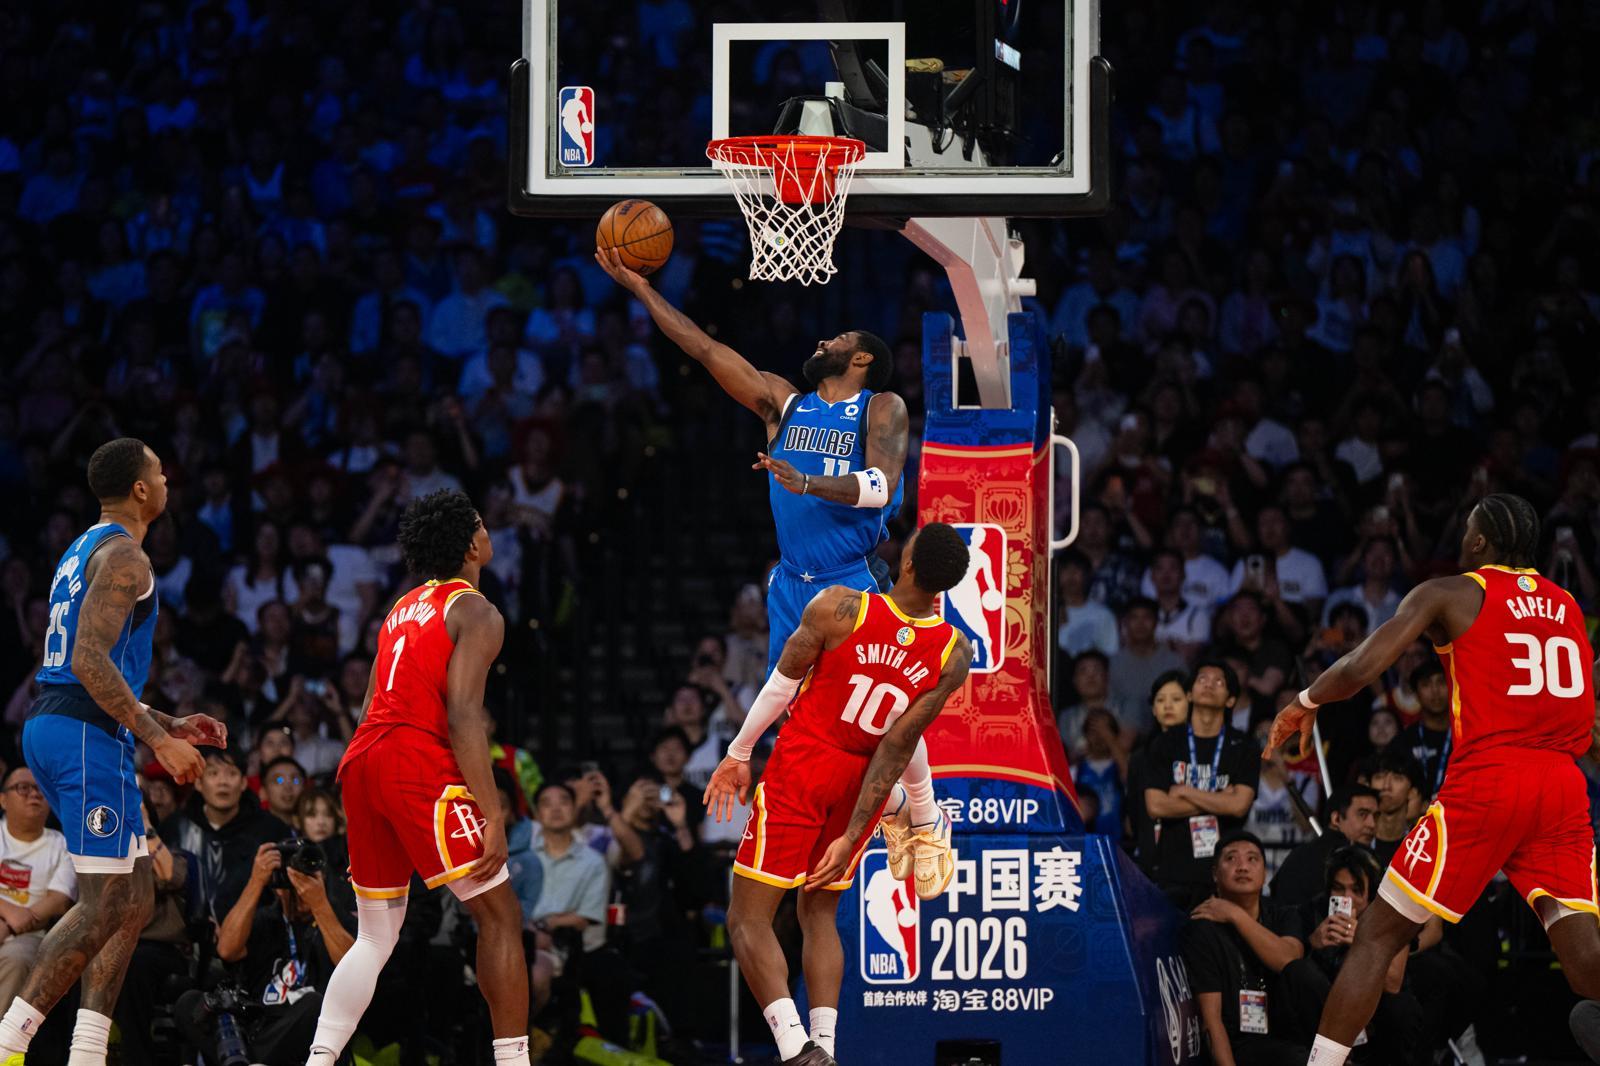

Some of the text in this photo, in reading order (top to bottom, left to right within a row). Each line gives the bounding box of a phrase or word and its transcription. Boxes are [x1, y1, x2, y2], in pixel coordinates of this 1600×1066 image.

[564, 148, 581, 161] NBA
[784, 425, 856, 458] DALLAS
[386, 601, 437, 635] THOMPSON
[1506, 595, 1566, 625] CAPELA
[43, 601, 71, 667] 25
[385, 634, 406, 692] 1
[855, 643, 930, 689] SMITH JR.
[1503, 632, 1585, 699] 30
[840, 673, 910, 736] 10
[943, 846, 1082, 913] 中国赛
[869, 953, 898, 975] NBA
[931, 917, 1028, 981] 2026
[863, 991, 928, 1007] 首席合作伙伴
